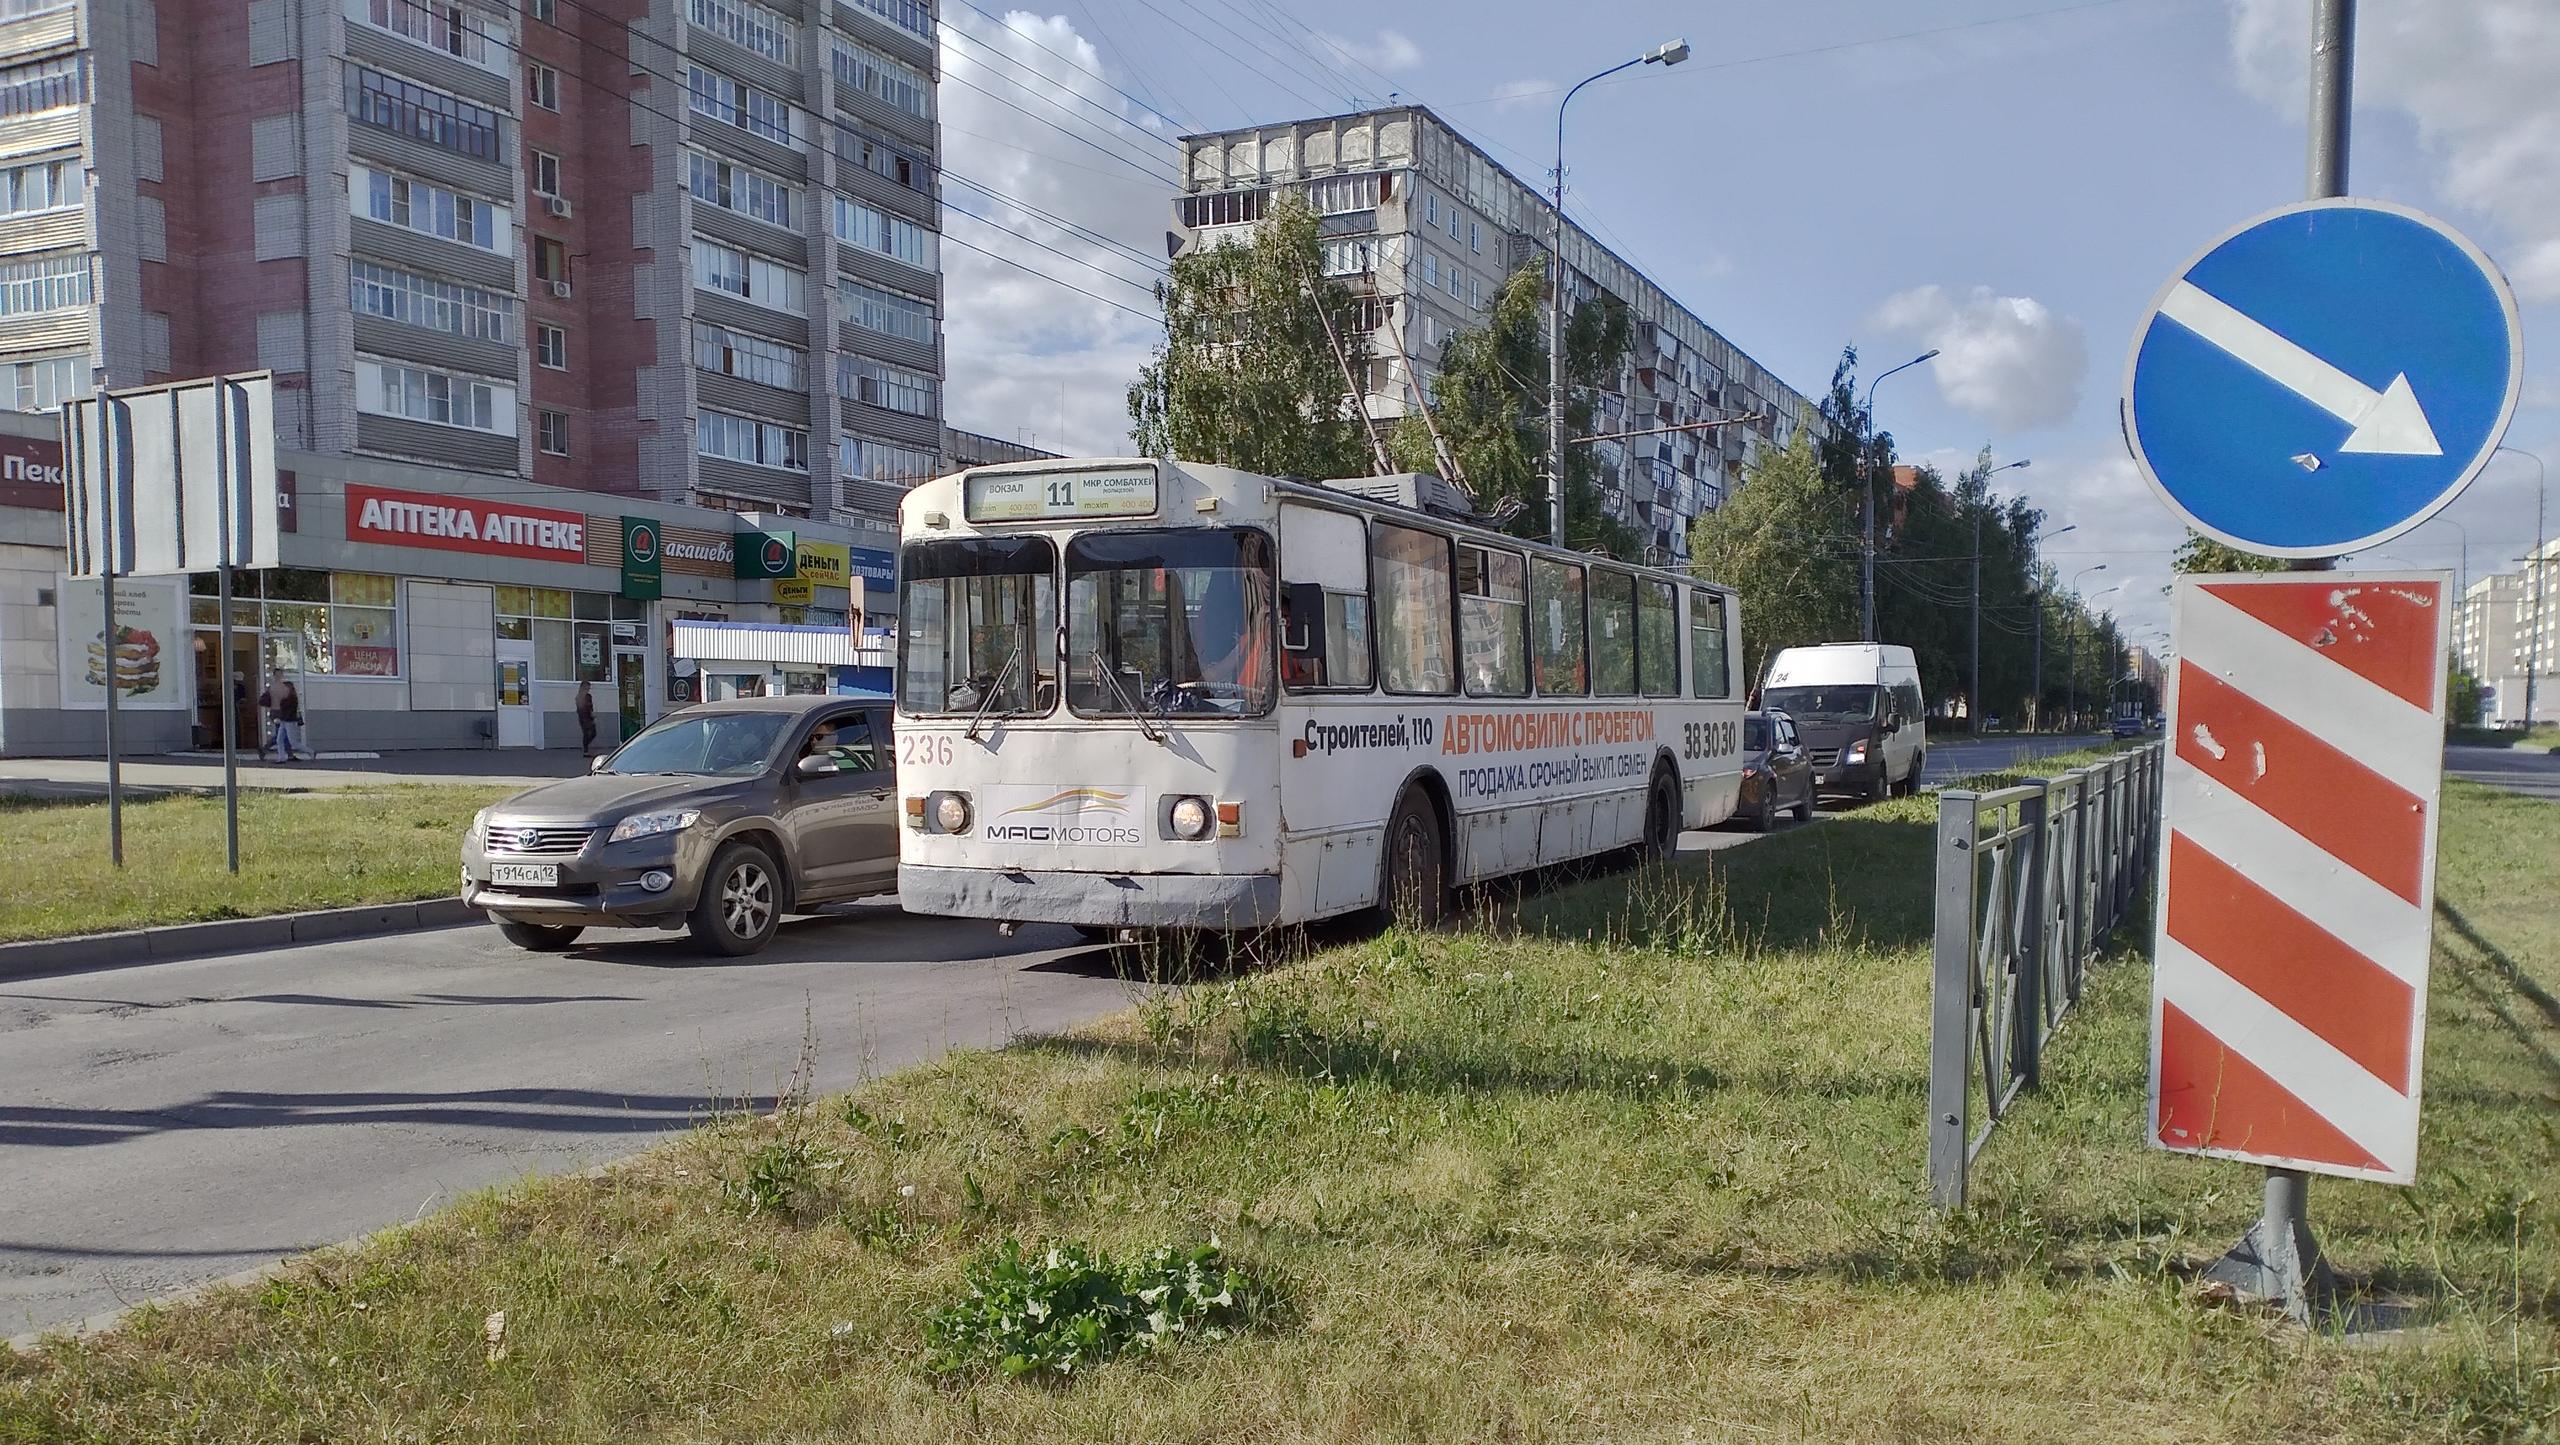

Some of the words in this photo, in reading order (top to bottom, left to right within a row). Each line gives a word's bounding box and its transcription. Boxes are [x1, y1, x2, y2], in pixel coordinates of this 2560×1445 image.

[989, 483, 1024, 494] ВОКЗАЛ
[1047, 482, 1075, 506] 11
[358, 498, 478, 540] АПТЕКА
[481, 512, 583, 552] АПТЕКЕ
[665, 541, 734, 563] акашево
[800, 554, 839, 571] ДЕНЬГИ
[851, 564, 894, 580] ХОЗТОВАРЫ
[782, 586, 808, 596] ДЕНЬГИ
[354, 650, 378, 661] ЦЕНА
[1775, 672, 1789, 683] 24
[1305, 714, 1410, 756] Строителей,
[1412, 717, 1433, 746] 110
[1441, 711, 1570, 756] АВТОМОБИЛИ
[1572, 711, 1582, 747] С
[1684, 722, 1701, 760] 38
[1703, 722, 1719, 758] 30
[1721, 721, 1736, 756] 30
[902, 734, 954, 767] 236
[1459, 764, 1528, 800] ПРОДАЖА.
[1529, 753, 1581, 789] СРОЧНЫЙ
[1582, 757, 1617, 783] ВЫКУП.
[1617, 753, 1647, 778] ОБМЕН
[542, 866, 554, 877] 12
